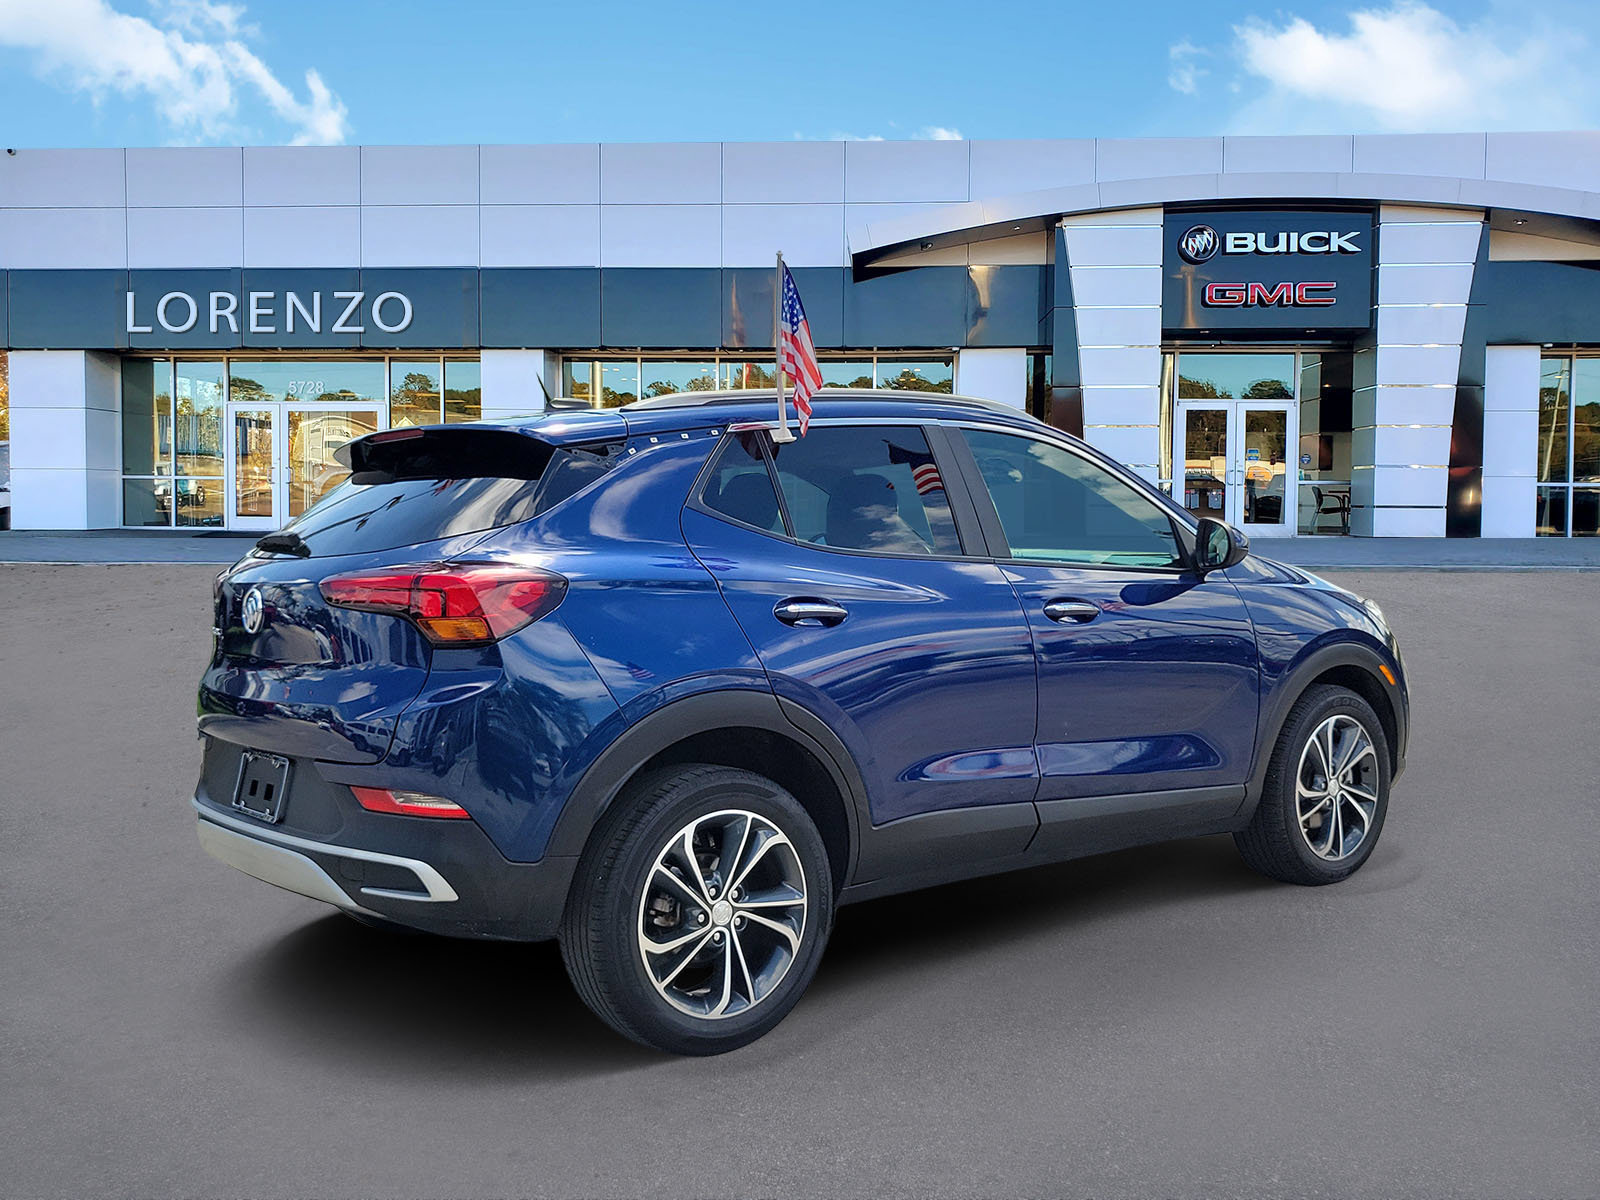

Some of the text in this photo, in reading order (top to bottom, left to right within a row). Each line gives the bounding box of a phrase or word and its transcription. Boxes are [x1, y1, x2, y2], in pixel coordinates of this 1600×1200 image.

[1225, 231, 1362, 253] BUICK
[1204, 282, 1337, 305] GMC
[126, 291, 413, 333] LORENZO
[288, 380, 325, 394] 5728
